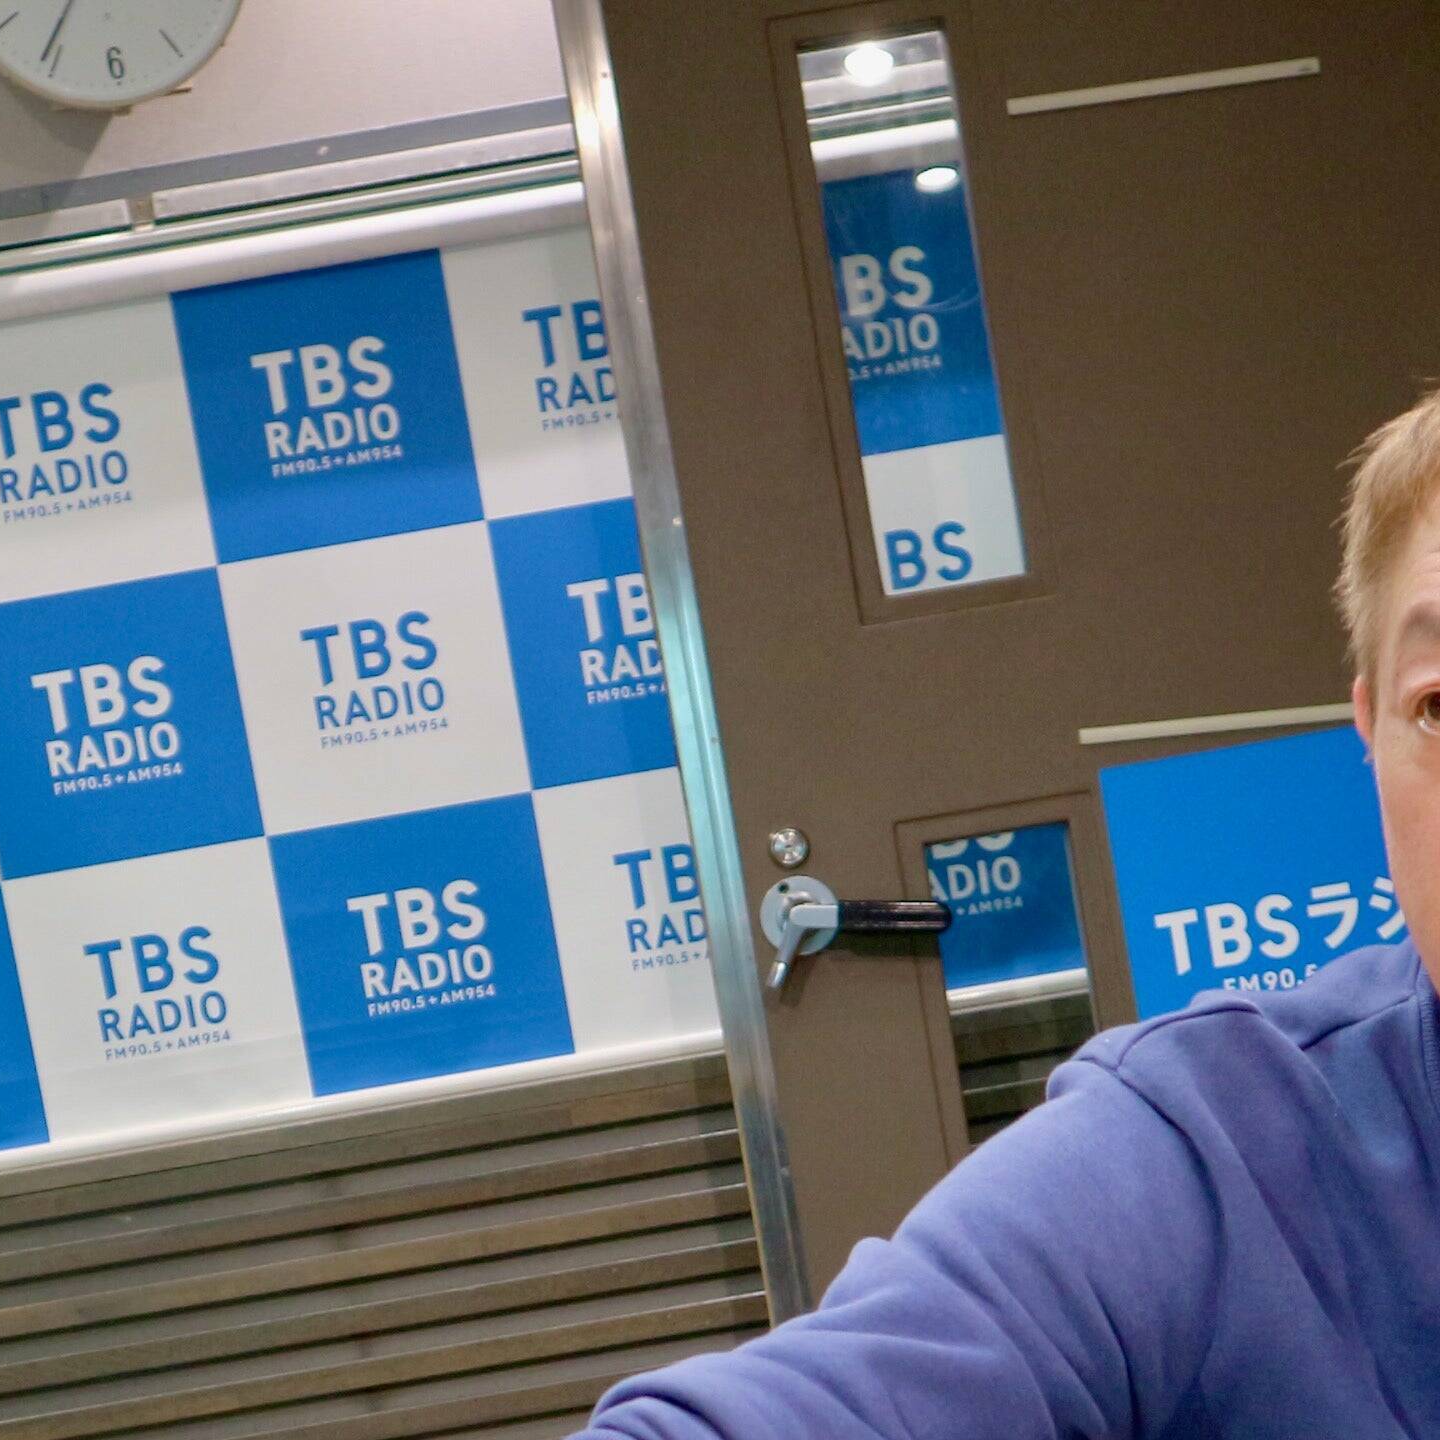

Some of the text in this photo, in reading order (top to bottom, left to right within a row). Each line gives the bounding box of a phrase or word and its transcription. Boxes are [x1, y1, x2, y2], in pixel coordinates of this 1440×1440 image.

[106, 46, 124, 79] 6
[841, 245, 934, 316] BS
[522, 298, 609, 368] TB
[250, 335, 393, 415] TBS
[535, 367, 617, 413] RAD
[263, 403, 401, 460] RADIO
[883, 520, 974, 591] BS
[566, 572, 654, 643] TB
[299, 610, 438, 687] TBS
[580, 640, 663, 686] RAD
[30, 655, 173, 734] TBS
[314, 676, 445, 731] RADIO
[45, 721, 180, 778] RADIO
[613, 843, 700, 909] TB
[346, 879, 486, 956] TBS
[626, 909, 707, 952] RAD
[83, 925, 220, 1000] TBS
[360, 944, 493, 999] RADIO
[98, 990, 228, 1043] RADIO
